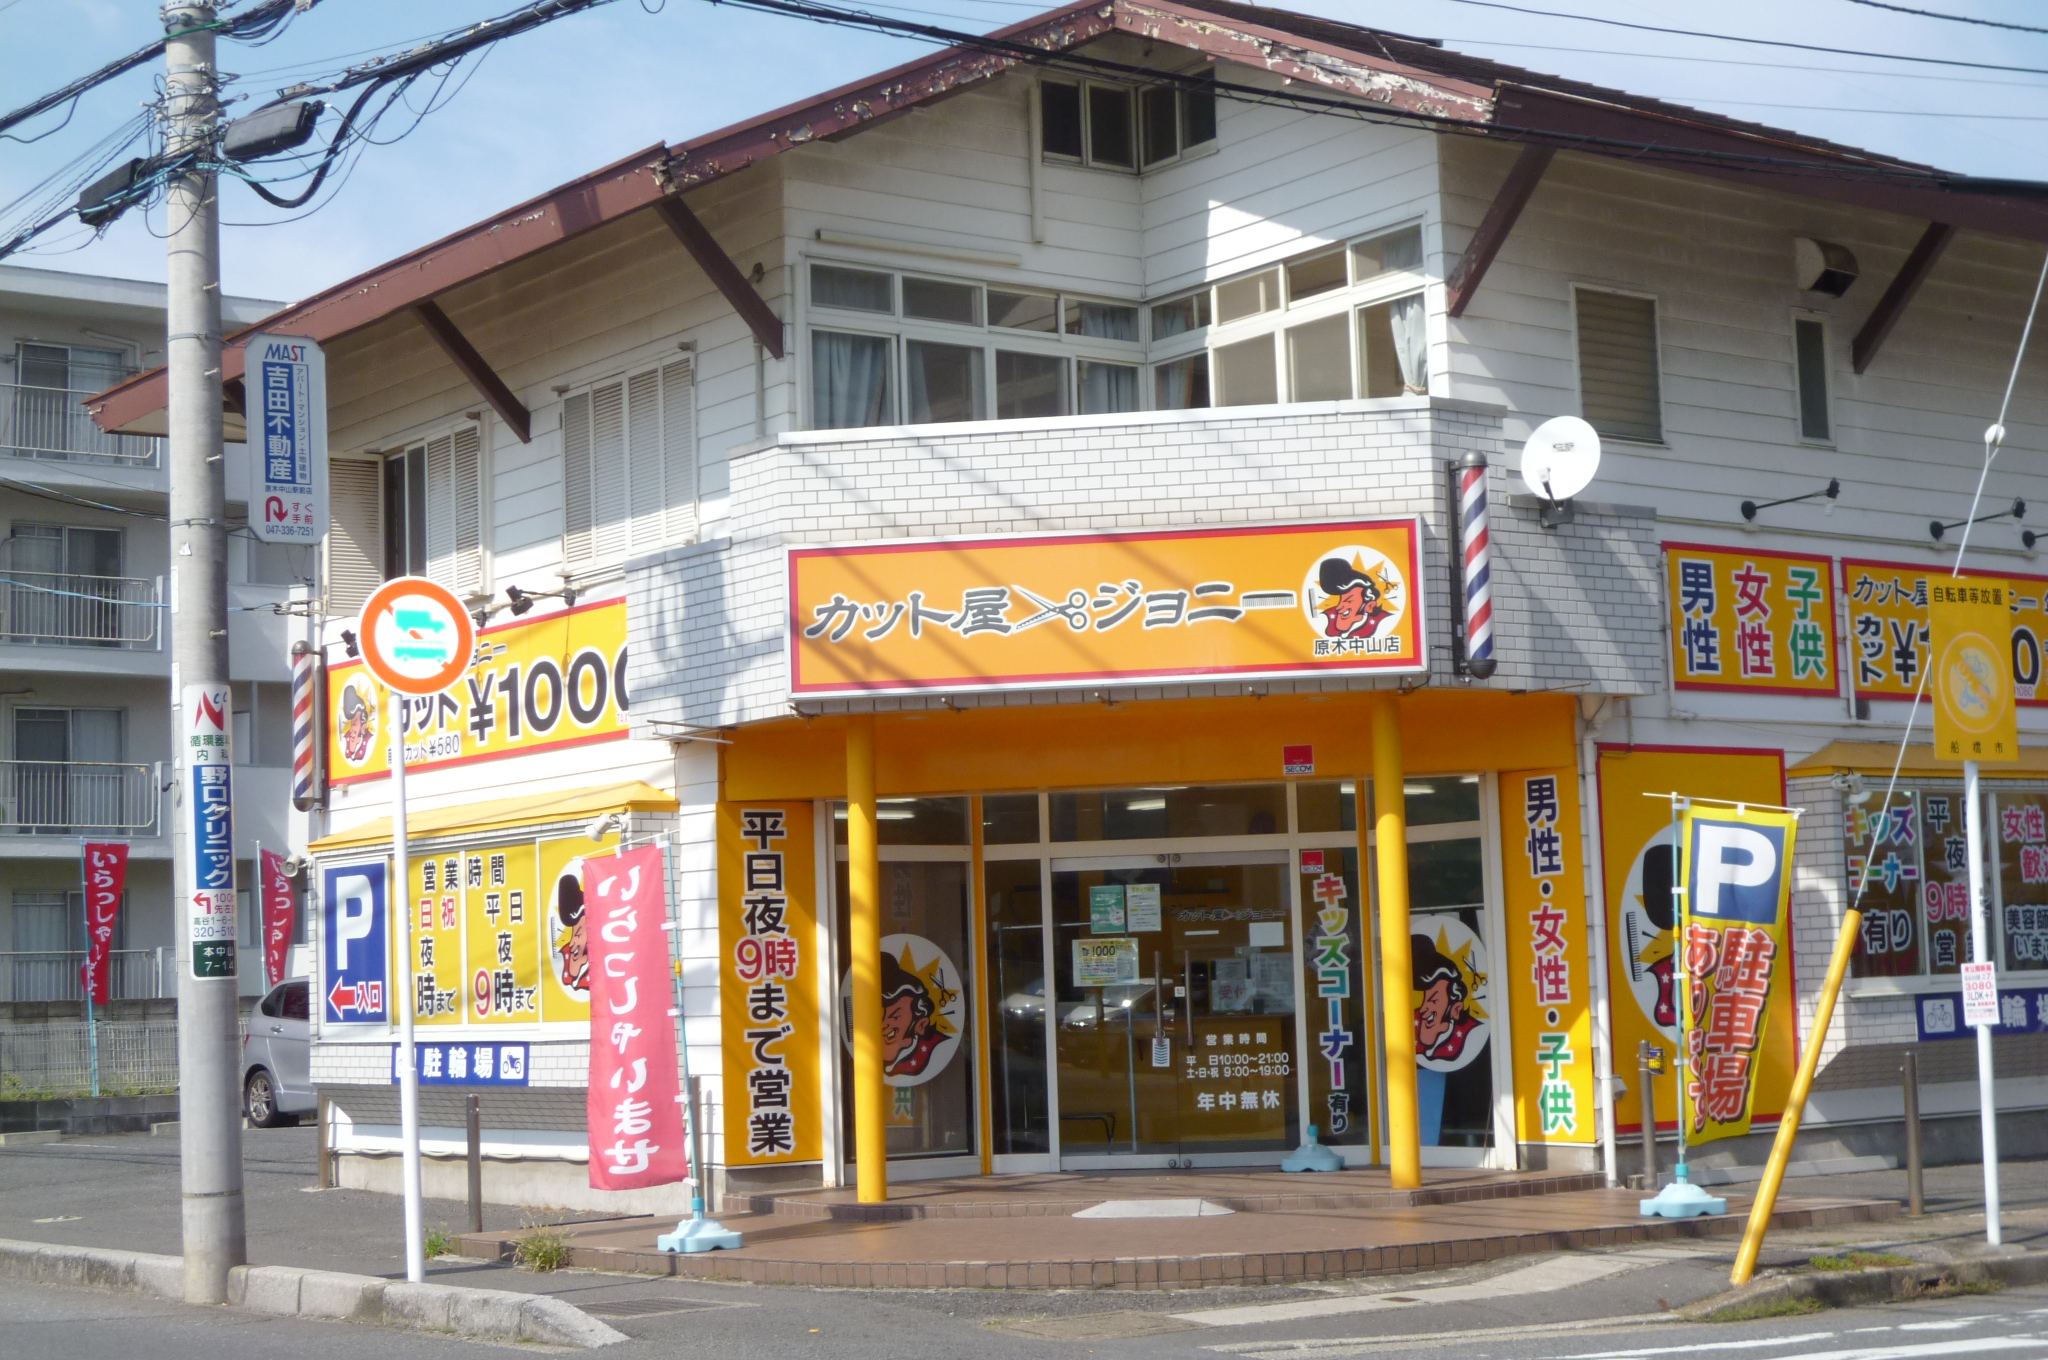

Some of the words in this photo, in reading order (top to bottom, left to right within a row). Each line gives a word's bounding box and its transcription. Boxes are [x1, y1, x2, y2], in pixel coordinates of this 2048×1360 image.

[264, 343, 307, 362] MAST
[266, 365, 293, 480] 吉田不動産
[291, 502, 314, 513] すぐ
[291, 513, 314, 525] 手前
[265, 525, 314, 536] 047-336-7251
[804, 588, 1012, 642] カット屋
[1933, 585, 2003, 606] 自転車等放置
[1680, 560, 1720, 673] 男性
[1735, 564, 1774, 676] 女性
[1787, 568, 1826, 678] 子供
[1313, 635, 1401, 656] 原木中山店
[1950, 740, 2003, 754] 船橋市
[201, 765, 230, 888] 野口クリニック
[1845, 803, 1917, 846] キッズ
[2003, 806, 2045, 842] 女性
[422, 854, 506, 893] 営業時間
[1696, 824, 1777, 914] P
[1848, 853, 1919, 893] コーナー
[336, 873, 374, 971] P
[486, 891, 523, 925] 平日
[497, 931, 513, 964] 夜
[1863, 911, 1911, 952] 有り
[419, 936, 435, 968] 夜
[1525, 776, 1576, 1134] 男性・女性・子供
[357, 982, 383, 1014] 入口
[474, 969, 537, 1016] 9時まで
[735, 810, 797, 1155] 平日夜9時まで営業
[1206, 1032, 1268, 1046] 営業時間
[1704, 926, 1778, 1122] 駐車場
[423, 1046, 494, 1081] 駐輪場
[1197, 1089, 1281, 1112] 年中無休
